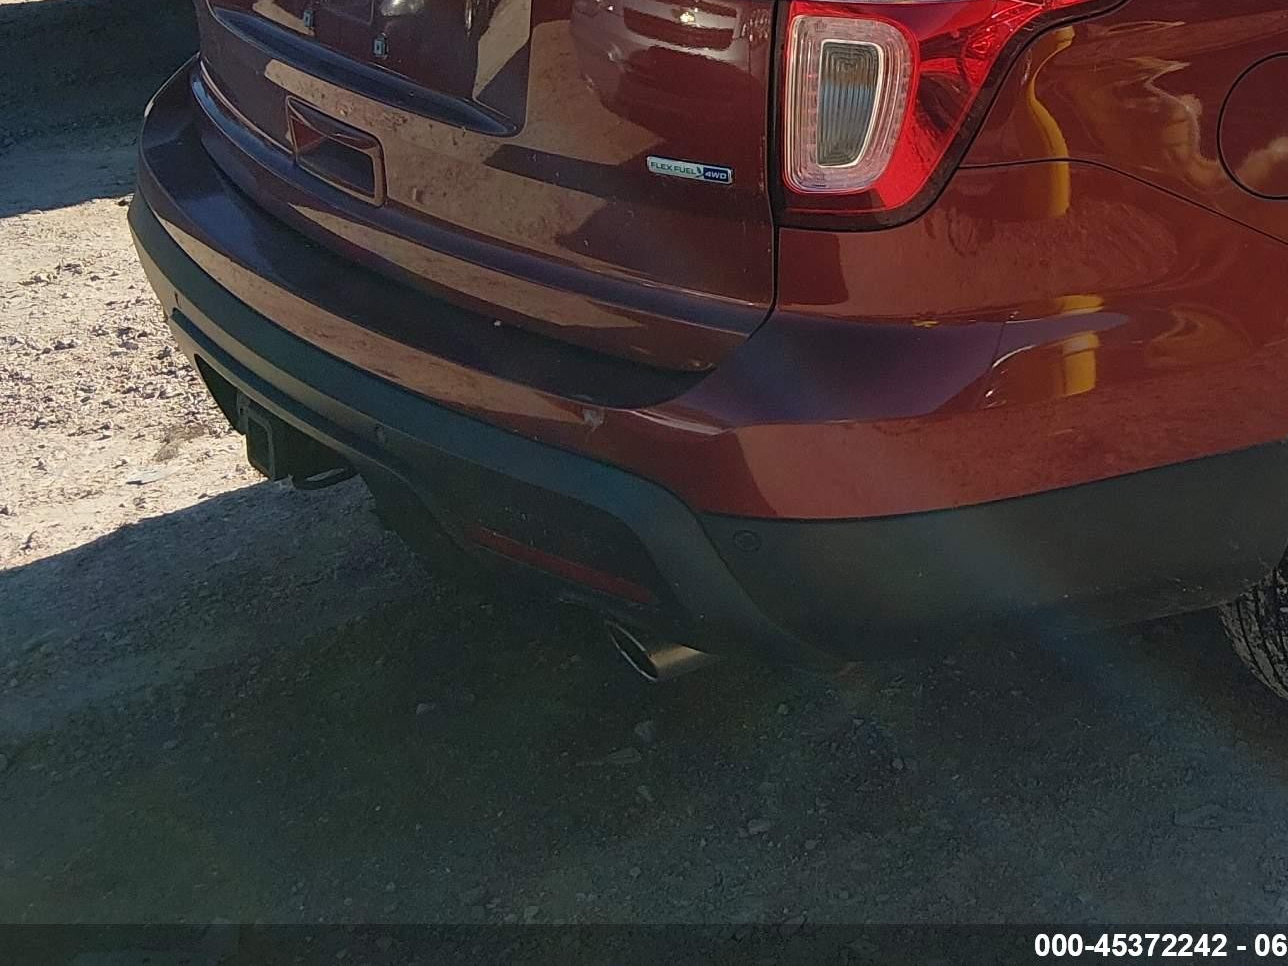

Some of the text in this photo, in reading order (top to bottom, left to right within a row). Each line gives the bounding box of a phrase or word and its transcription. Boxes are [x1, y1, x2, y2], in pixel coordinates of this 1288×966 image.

[650, 161, 727, 180] FLEX FUEL 4WD
